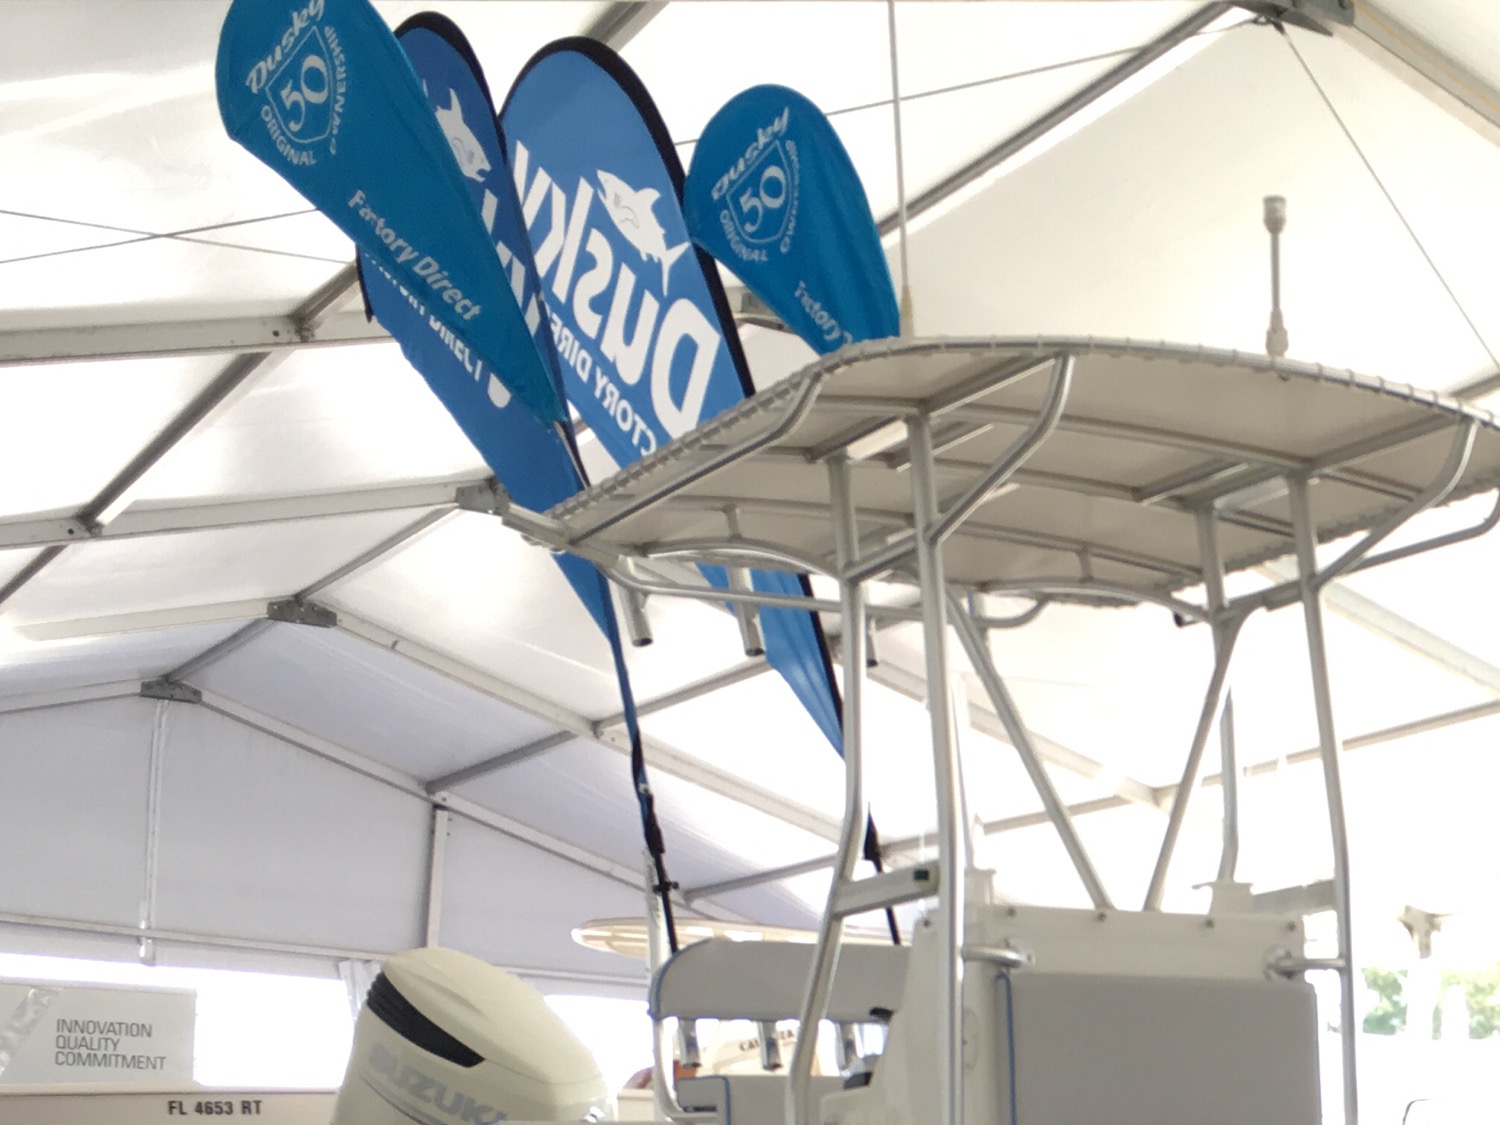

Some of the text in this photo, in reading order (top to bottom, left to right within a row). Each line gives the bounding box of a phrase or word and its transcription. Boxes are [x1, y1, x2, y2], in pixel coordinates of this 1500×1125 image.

[280, 54, 329, 132] 50
[261, 104, 317, 165] ORIGINAL
[739, 165, 786, 233] 50
[348, 189, 419, 263] Factory
[412, 255, 482, 321] Direct
[55, 1034, 121, 1053] QUALITY
[56, 1018, 153, 1038] INNOVATION
[54, 1050, 167, 1071] COMMITMENT
[168, 1099, 263, 1116] FL 4653 RT
